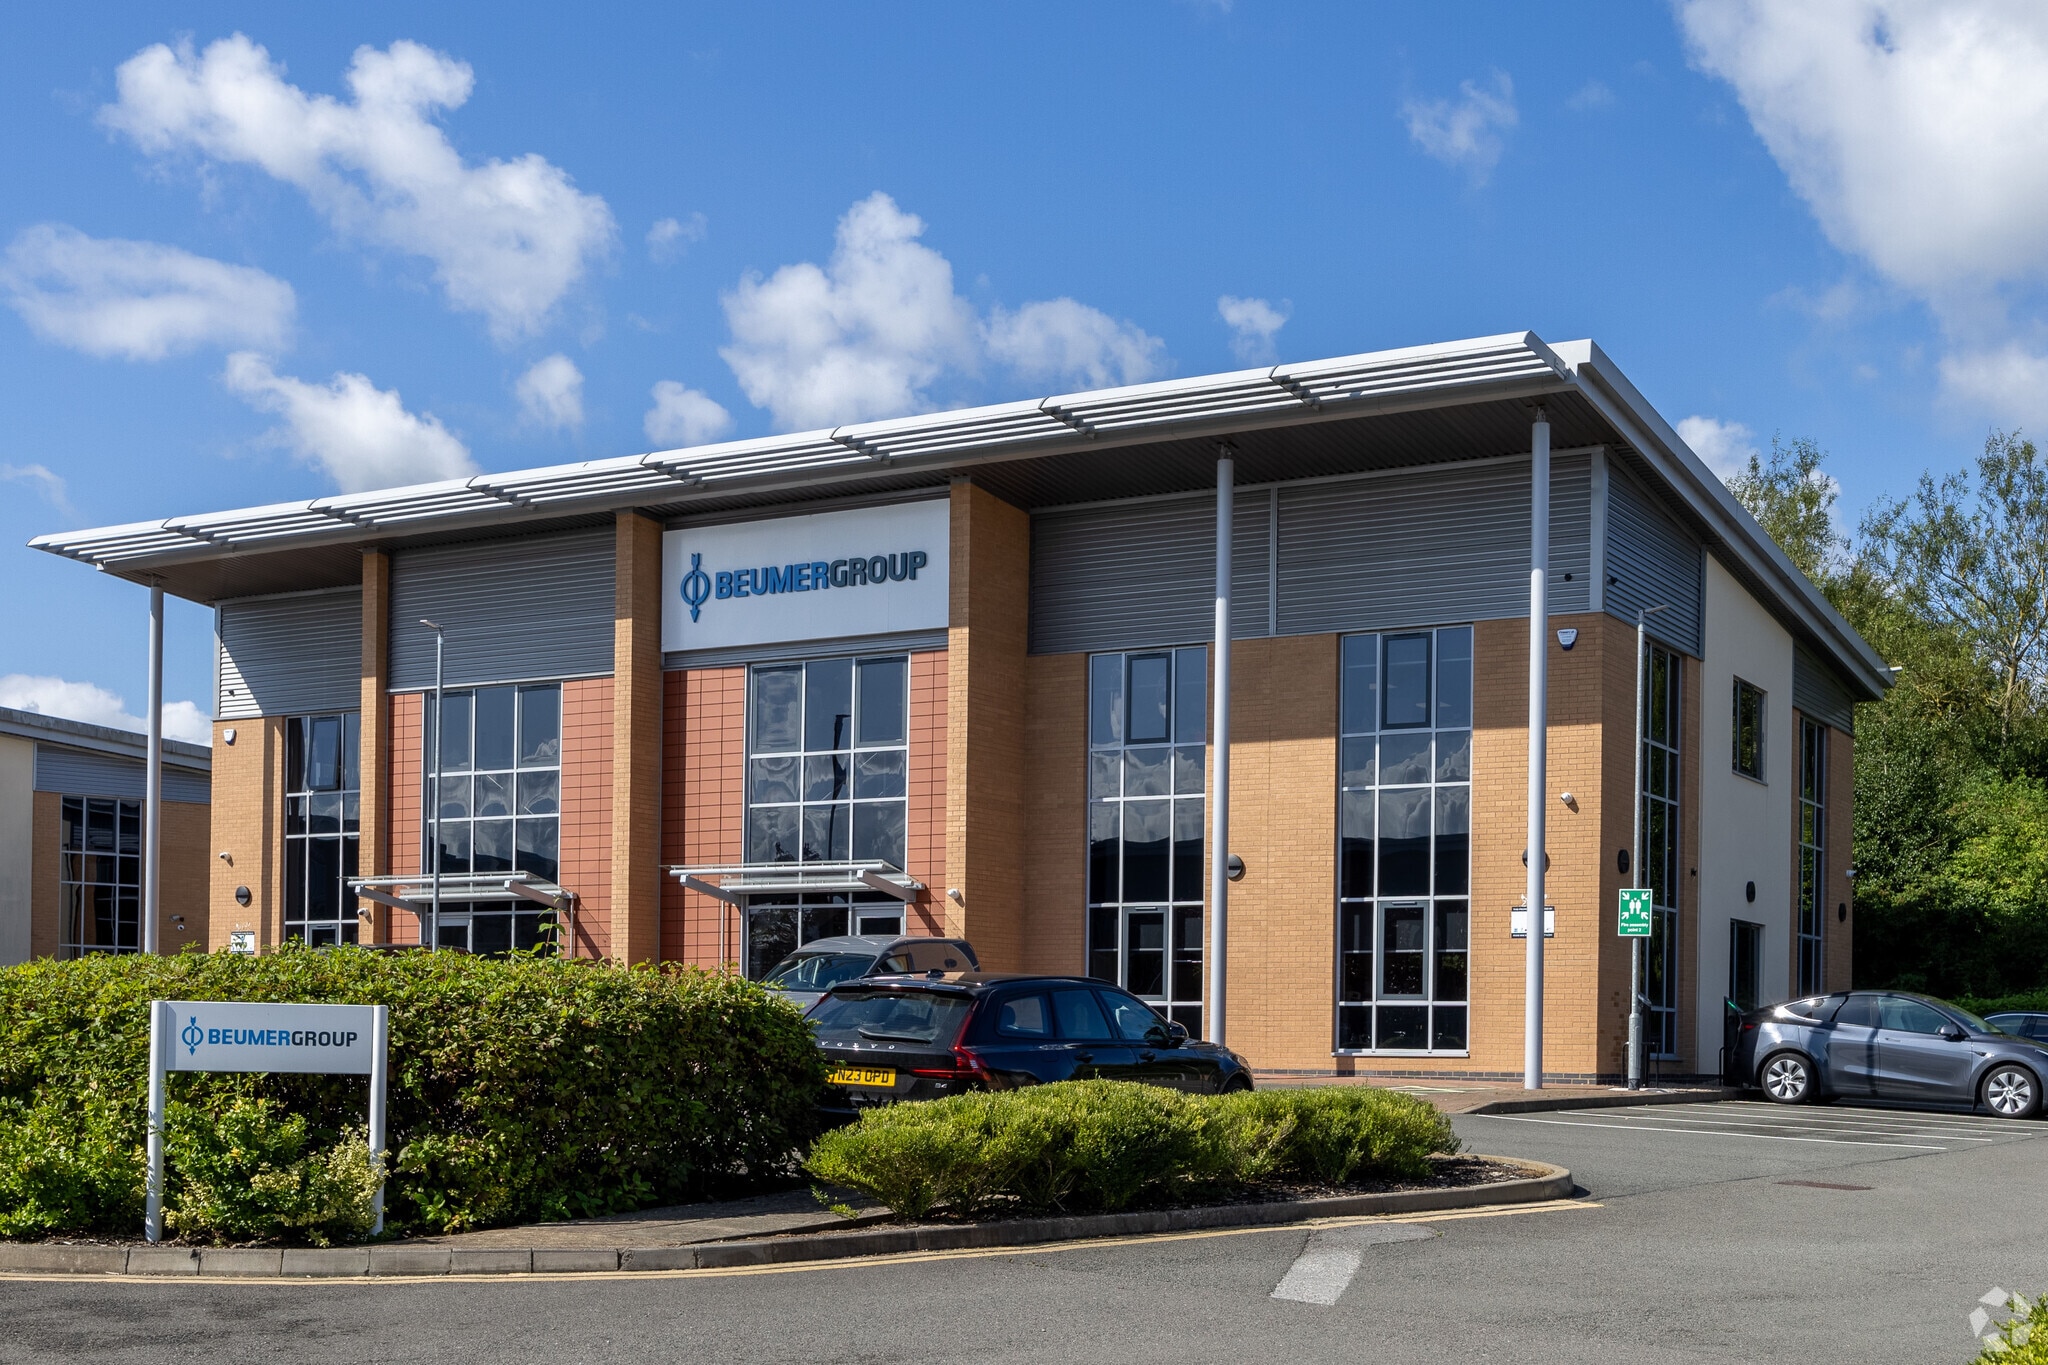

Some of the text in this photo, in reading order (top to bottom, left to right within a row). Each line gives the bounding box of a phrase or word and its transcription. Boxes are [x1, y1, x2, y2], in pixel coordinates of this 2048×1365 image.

[715, 550, 927, 600] BEUMERGROUP
[208, 1028, 358, 1047] BEUMERGROUP
[821, 1041, 895, 1050] VOLVO
[864, 1069, 889, 1083] OPD
